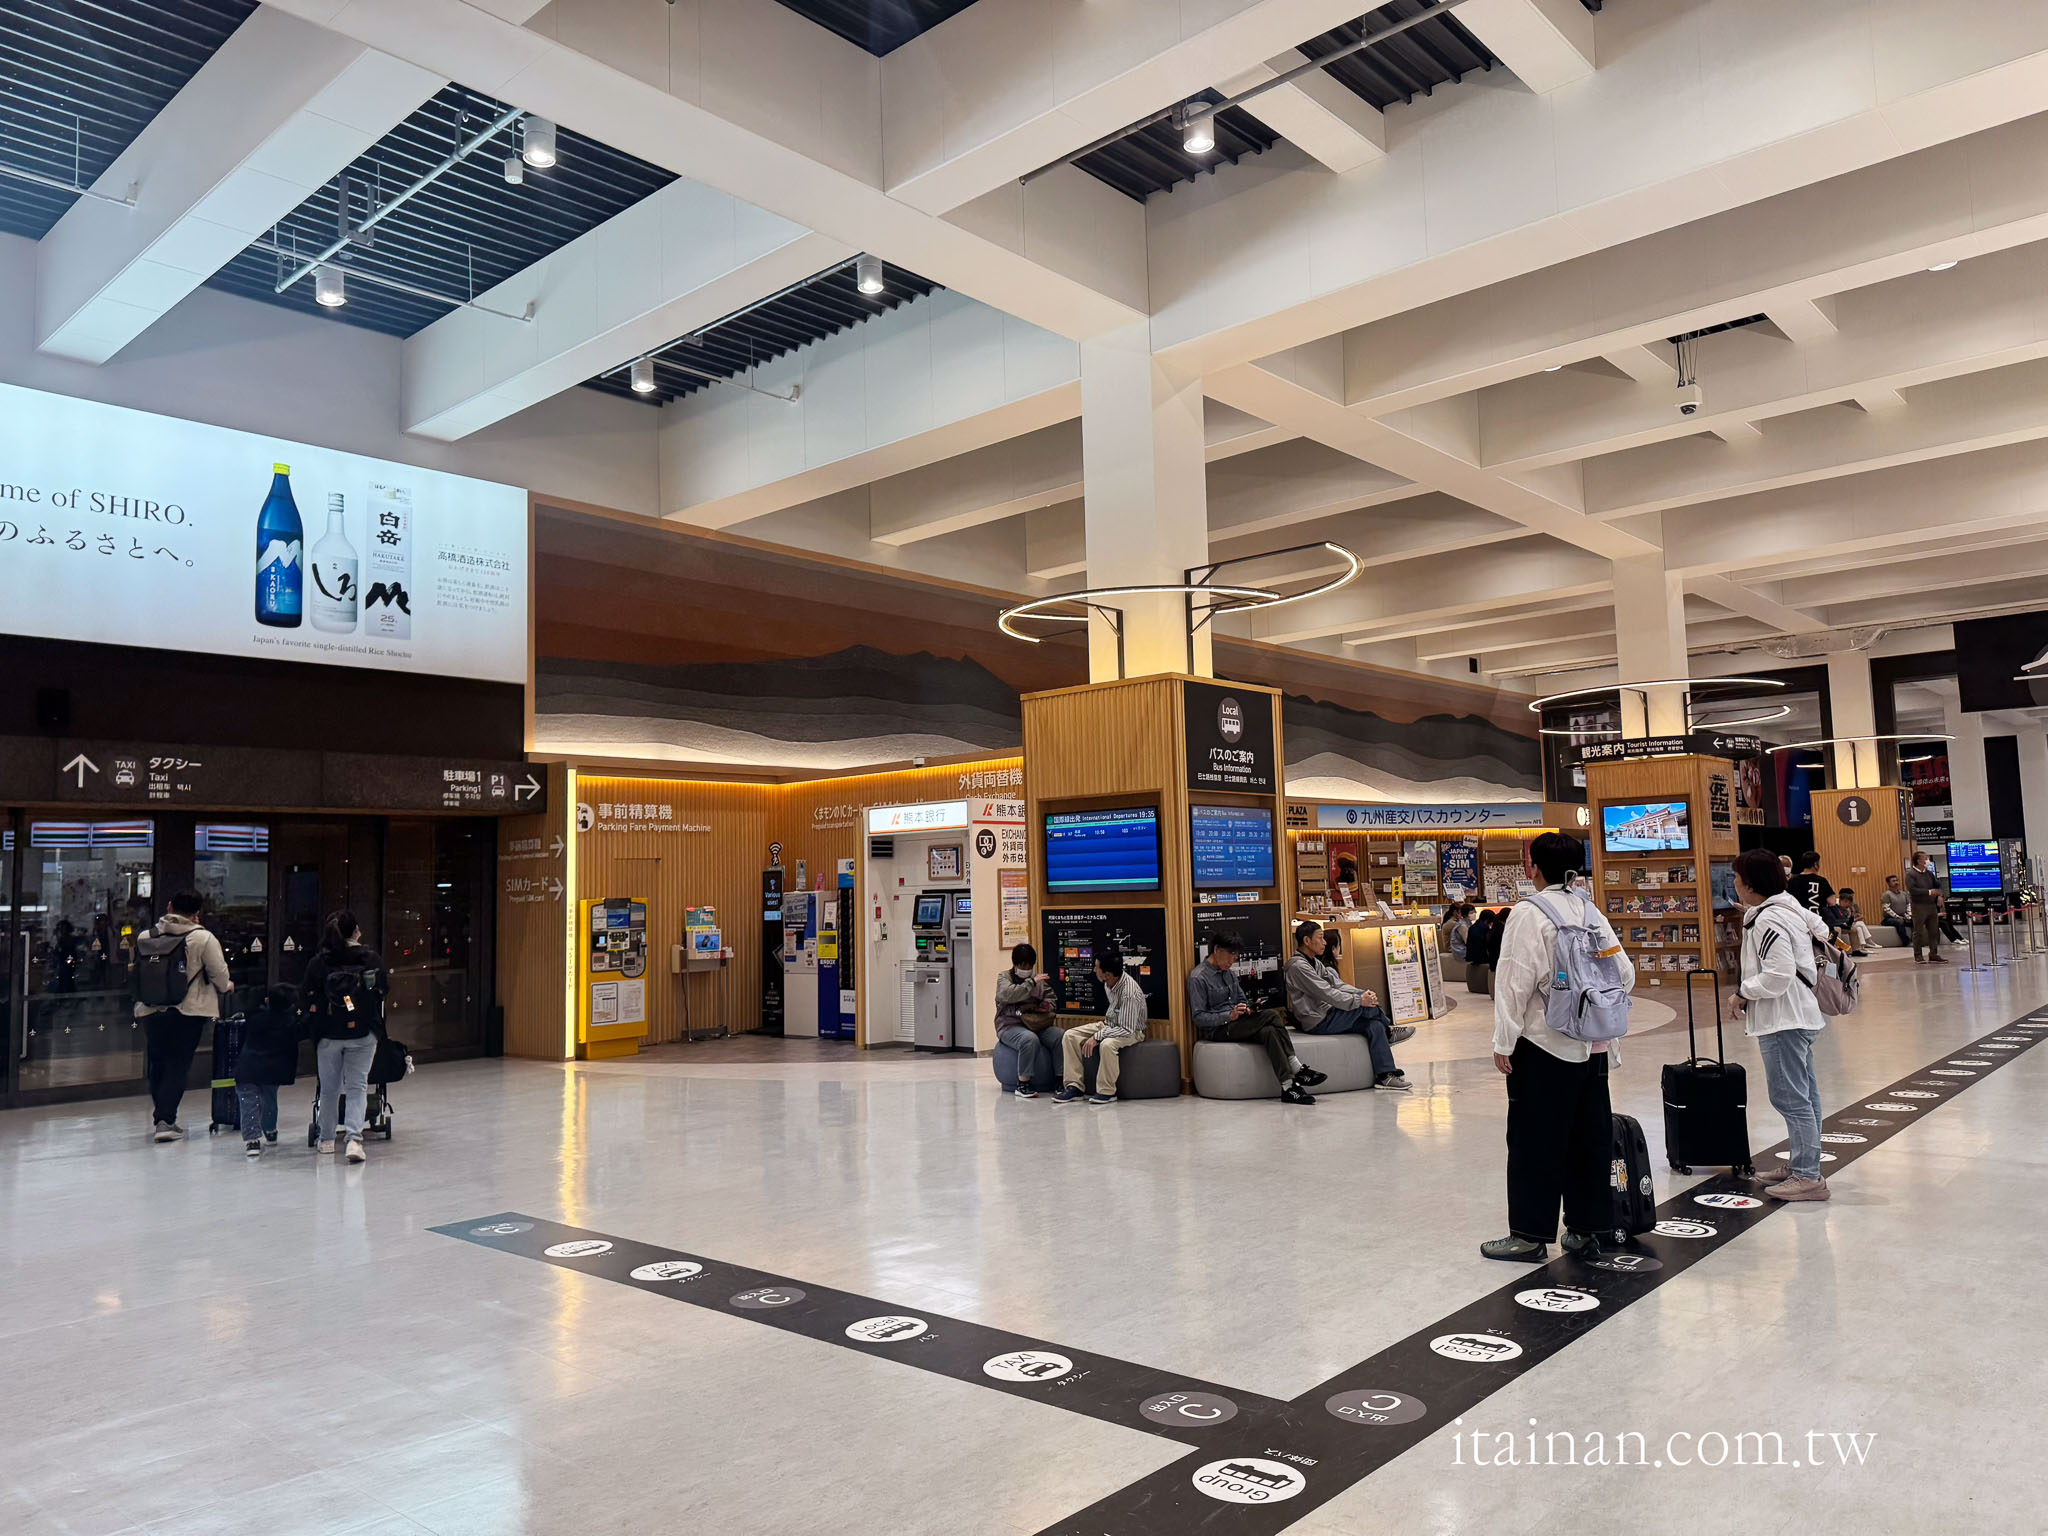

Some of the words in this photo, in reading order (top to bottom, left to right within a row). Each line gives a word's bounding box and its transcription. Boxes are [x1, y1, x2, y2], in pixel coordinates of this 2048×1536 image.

[52, 489, 82, 508] of
[90, 492, 193, 527] SHIRO.
[377, 512, 401, 546] 白岳
[253, 634, 281, 646] Japan's
[282, 638, 311, 648] favorite
[368, 647, 385, 656] Rice
[1222, 704, 1239, 716] Local
[1209, 748, 1254, 764] バスのご案内
[1582, 743, 1625, 758] 観光案内
[115, 761, 136, 769] TAXI
[149, 757, 202, 770] タクシー
[1213, 763, 1223, 772] Bus
[1224, 764, 1252, 773] Information
[149, 773, 168, 781] Taxi
[491, 775, 504, 785] P1
[959, 768, 1023, 790] 外貨両替機
[598, 803, 673, 820] 事前精算機
[1288, 806, 1308, 815] PLAZA
[1361, 809, 1507, 825] 九州産交バスカウンター
[597, 823, 628, 832] Parking
[630, 823, 647, 831] Fare
[648, 824, 681, 832] Payment
[682, 824, 711, 832] Machine
[1449, 860, 1470, 868] SIM
[506, 876, 548, 892] SIMカード
[1613, 1255, 1644, 1265] D
[758, 1293, 791, 1304] C
[1524, 1297, 1569, 1311] TAXI
[852, 1316, 901, 1333] Local
[1434, 1343, 1496, 1361] Local
[990, 1353, 1037, 1369] TAXI
[1148, 1394, 1188, 1413] 出入口
[1361, 1394, 1402, 1411] C
[1178, 1403, 1222, 1419] C
[1337, 1406, 1389, 1423] 出入口
[1198, 1473, 1270, 1501] Group
